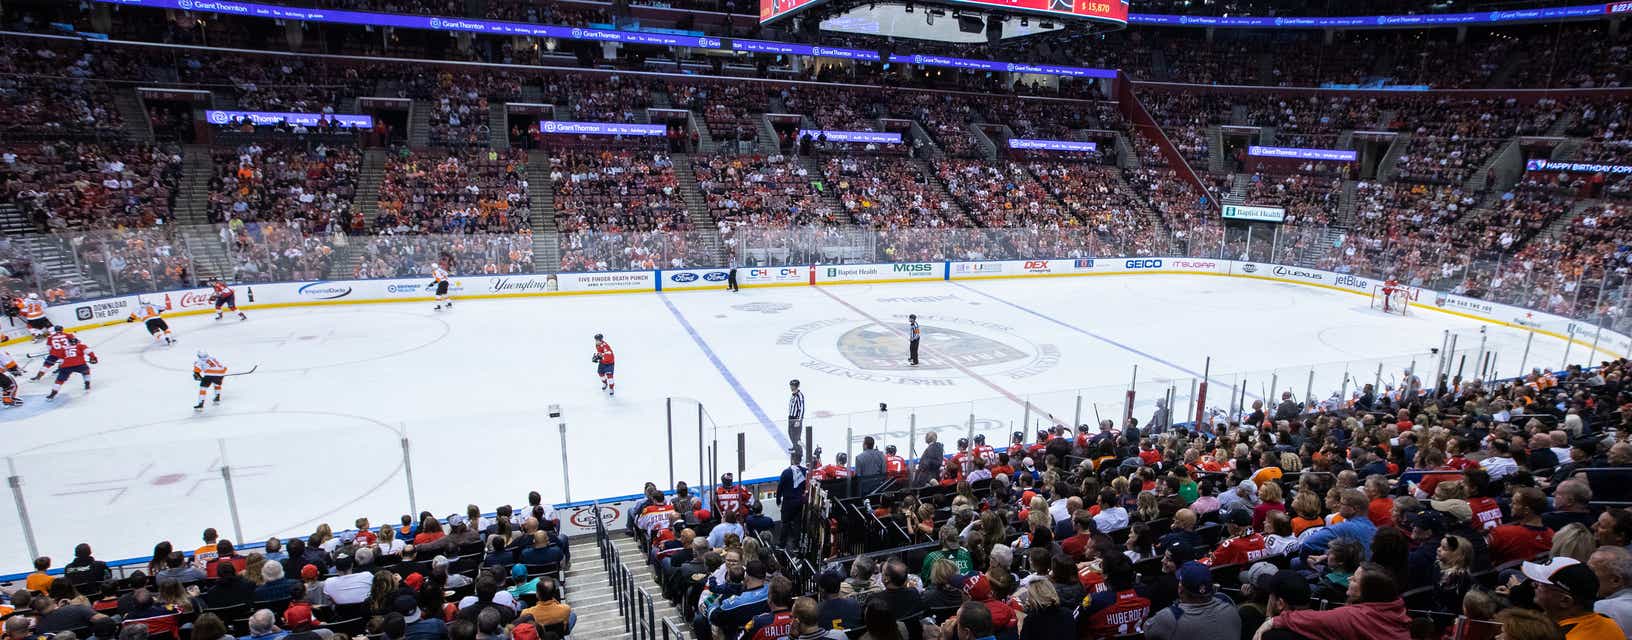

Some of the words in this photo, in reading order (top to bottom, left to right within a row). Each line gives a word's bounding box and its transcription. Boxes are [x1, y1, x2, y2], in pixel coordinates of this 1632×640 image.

[1547, 162, 1572, 170] HAPPY
[1024, 260, 1048, 269] DEX
[1126, 260, 1162, 268] GEICO
[1287, 270, 1322, 280] LEXUS
[490, 277, 546, 294] Yuengling
[1335, 274, 1368, 288] jetBlue
[93, 300, 127, 311] DOWNLOAD
[108, 309, 120, 317] APP
[892, 460, 900, 472] 7
